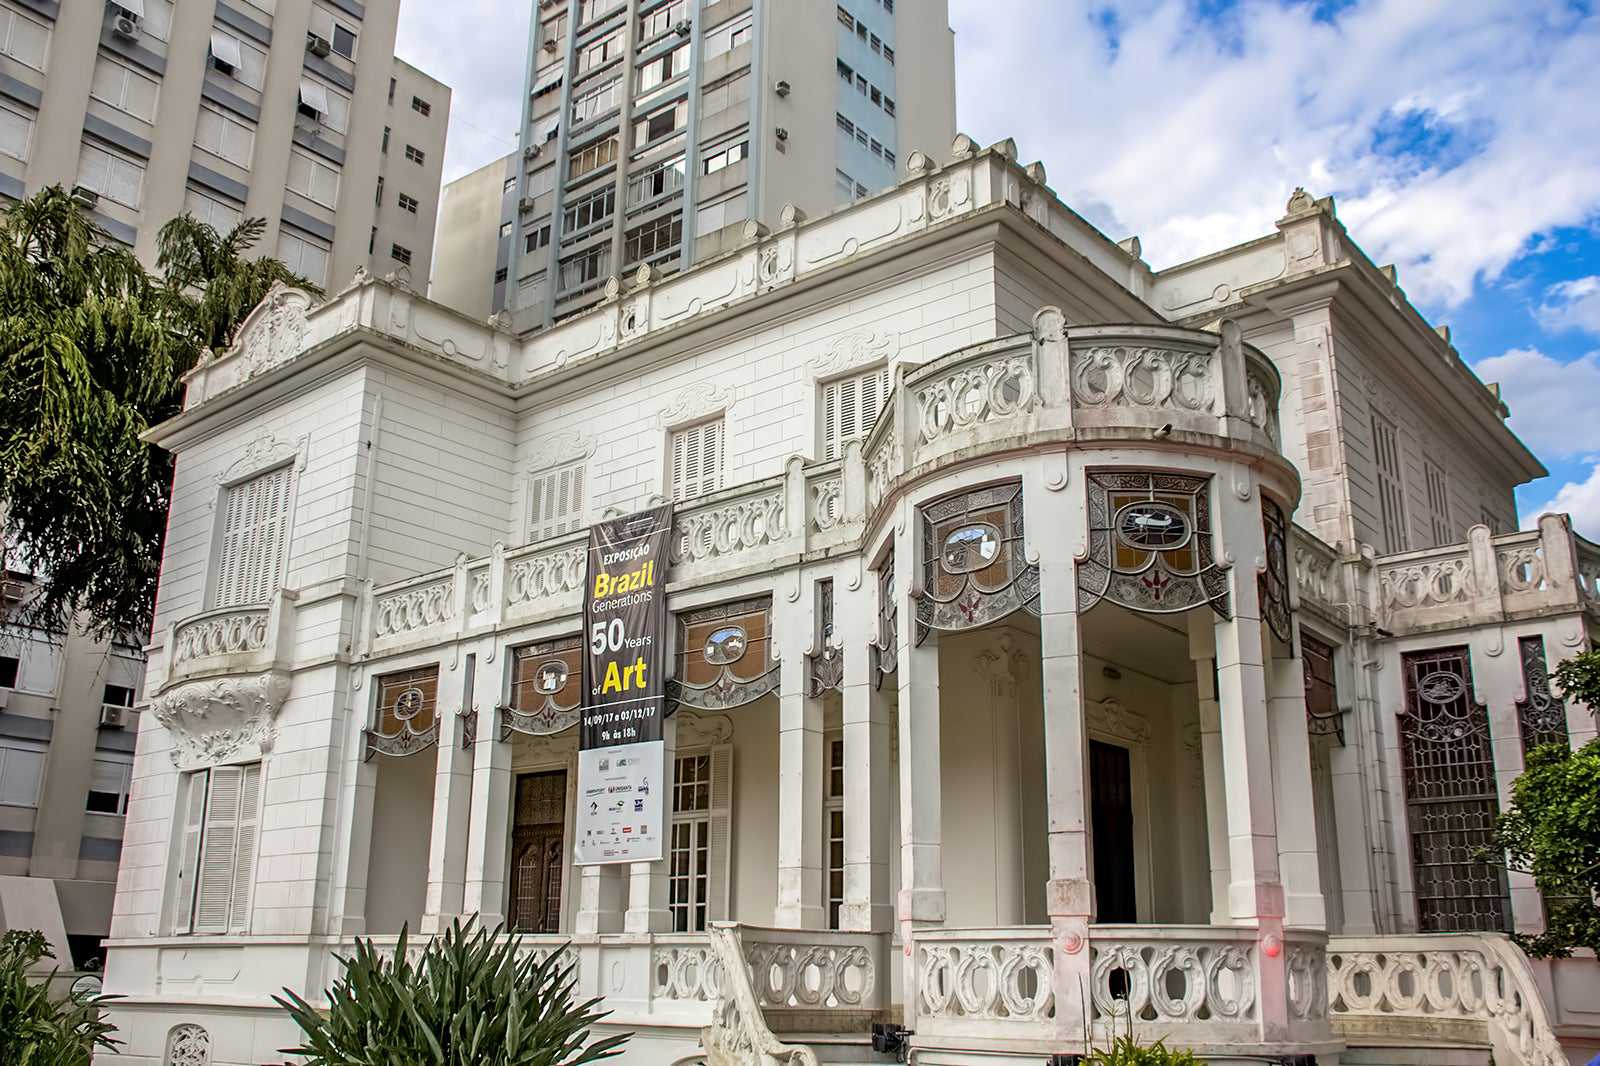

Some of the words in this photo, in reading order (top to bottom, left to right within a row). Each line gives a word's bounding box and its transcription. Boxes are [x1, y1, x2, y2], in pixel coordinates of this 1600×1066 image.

[604, 543, 650, 566] EXPOSIÇÃO
[594, 560, 653, 598] Brazil
[592, 591, 652, 613] Generations
[592, 618, 624, 655] 50
[624, 636, 651, 648] Years
[592, 684, 600, 695] of
[602, 656, 646, 694] Art
[584, 713, 614, 727] 14/09/17
[621, 706, 655, 722] 03/12/17
[602, 731, 610, 740] 9h
[613, 730, 621, 738] às
[623, 727, 636, 738] 18h
